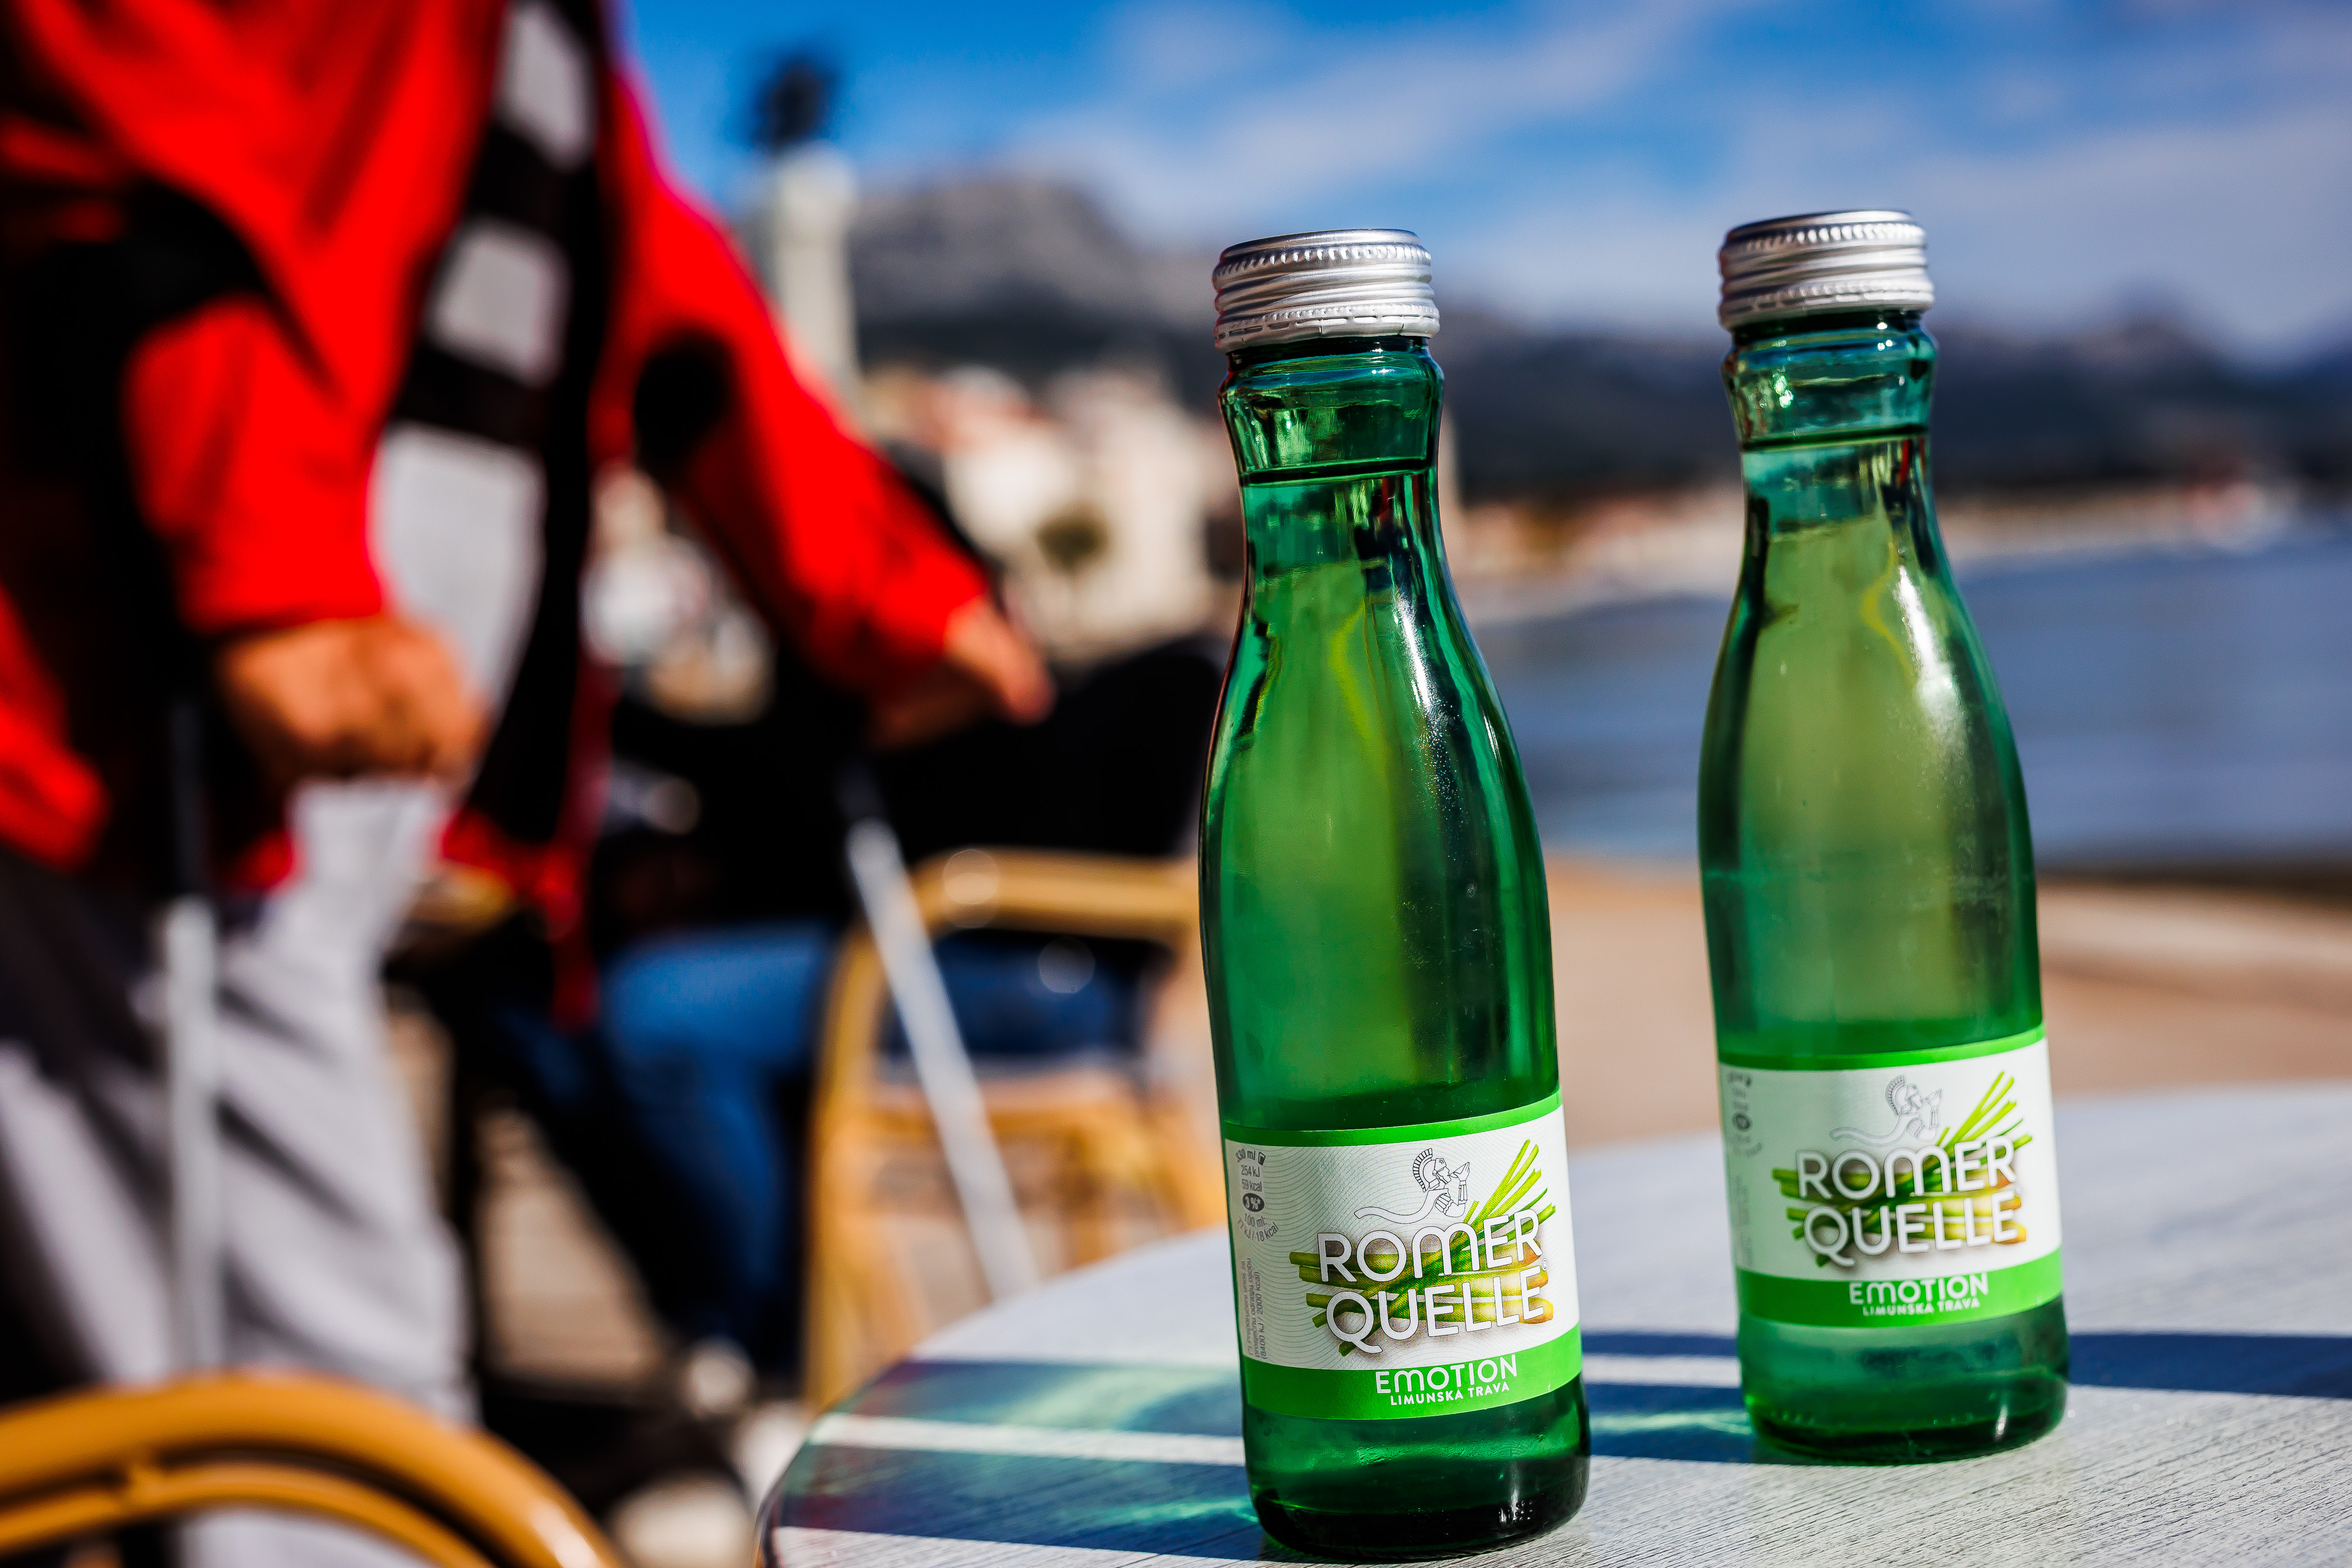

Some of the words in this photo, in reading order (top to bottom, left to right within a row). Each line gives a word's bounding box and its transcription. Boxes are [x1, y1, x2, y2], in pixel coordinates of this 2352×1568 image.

[1247, 1150, 1255, 1161] ml
[1796, 1136, 2017, 1200] ROMER
[1264, 1221, 1279, 1239] kcal
[1317, 1208, 1543, 1282] ROMER
[1803, 1189, 2018, 1267] QUELLE
[1849, 1272, 1989, 1305] EMOTION
[1862, 1302, 1935, 1316] LIMUNSKA
[1937, 1296, 1981, 1313] TRAVA
[1326, 1265, 1544, 1353] QUELLE
[1375, 1354, 1517, 1394] EMOTION
[1390, 1389, 1464, 1406] LIMUNSKA
[1468, 1381, 1509, 1398] TRAVA
